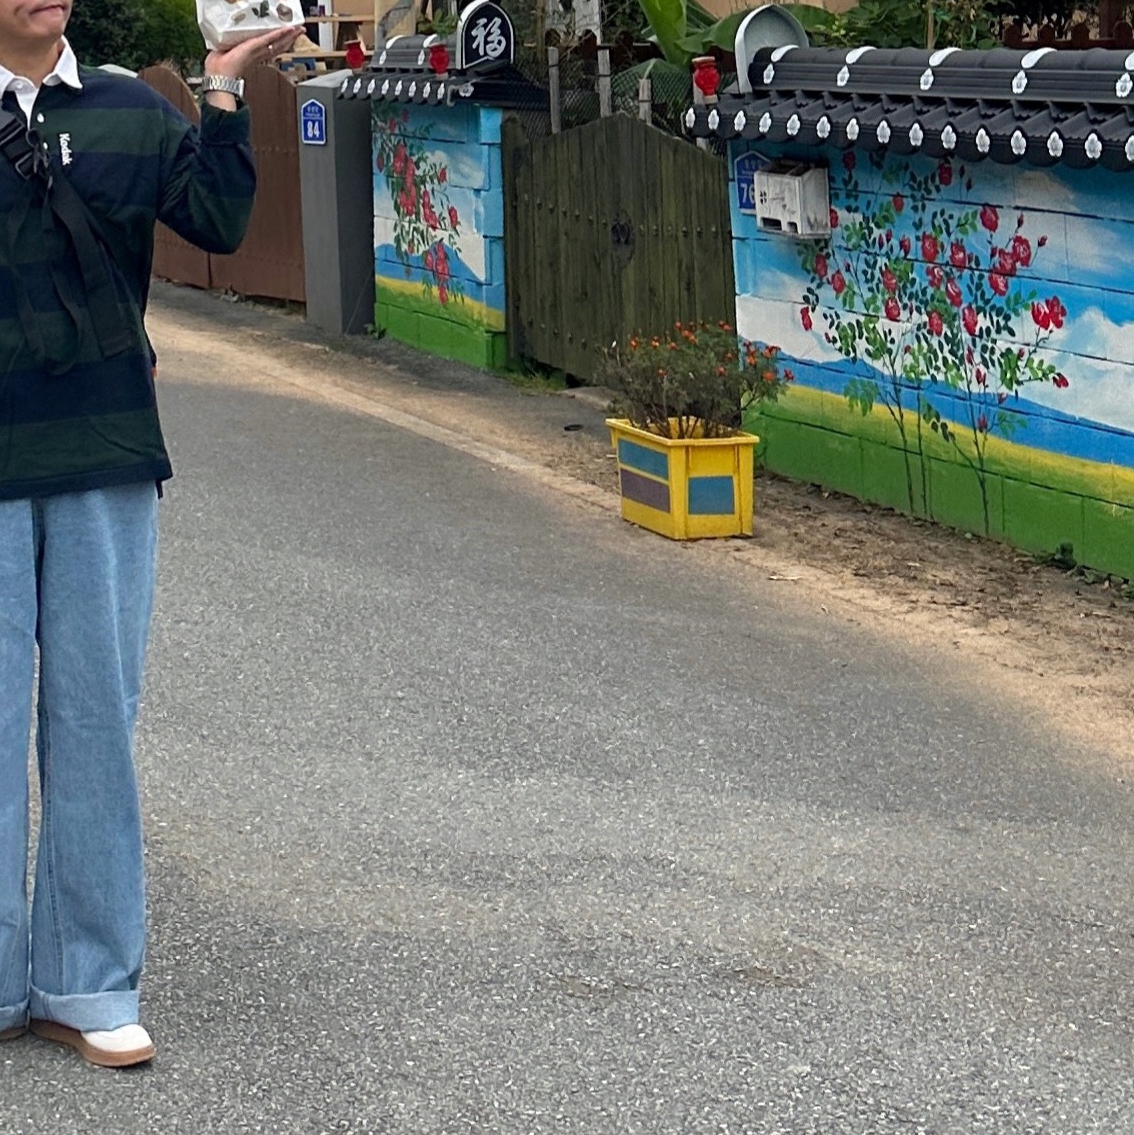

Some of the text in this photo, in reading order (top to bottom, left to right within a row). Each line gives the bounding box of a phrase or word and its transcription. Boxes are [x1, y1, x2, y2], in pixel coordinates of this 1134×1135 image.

[471, 17, 506, 57] 福
[307, 120, 320, 138] 84
[59, 133, 73, 166] Kodak
